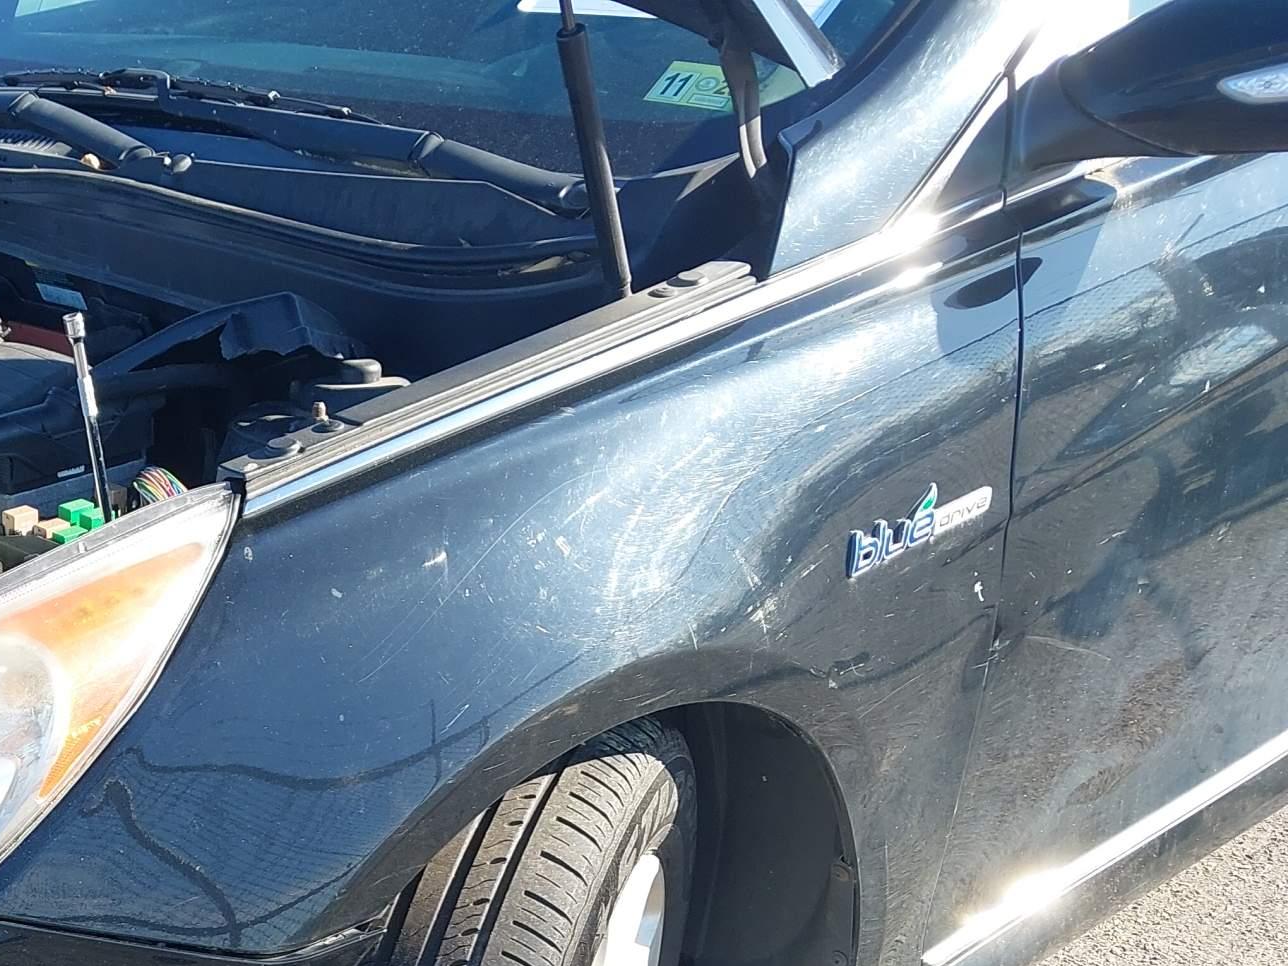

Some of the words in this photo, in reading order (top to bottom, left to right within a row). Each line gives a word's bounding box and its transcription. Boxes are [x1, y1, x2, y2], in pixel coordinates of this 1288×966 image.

[660, 72, 694, 97] 11
[712, 79, 729, 95] 2
[847, 500, 935, 578] blue
[938, 495, 988, 528] drive
